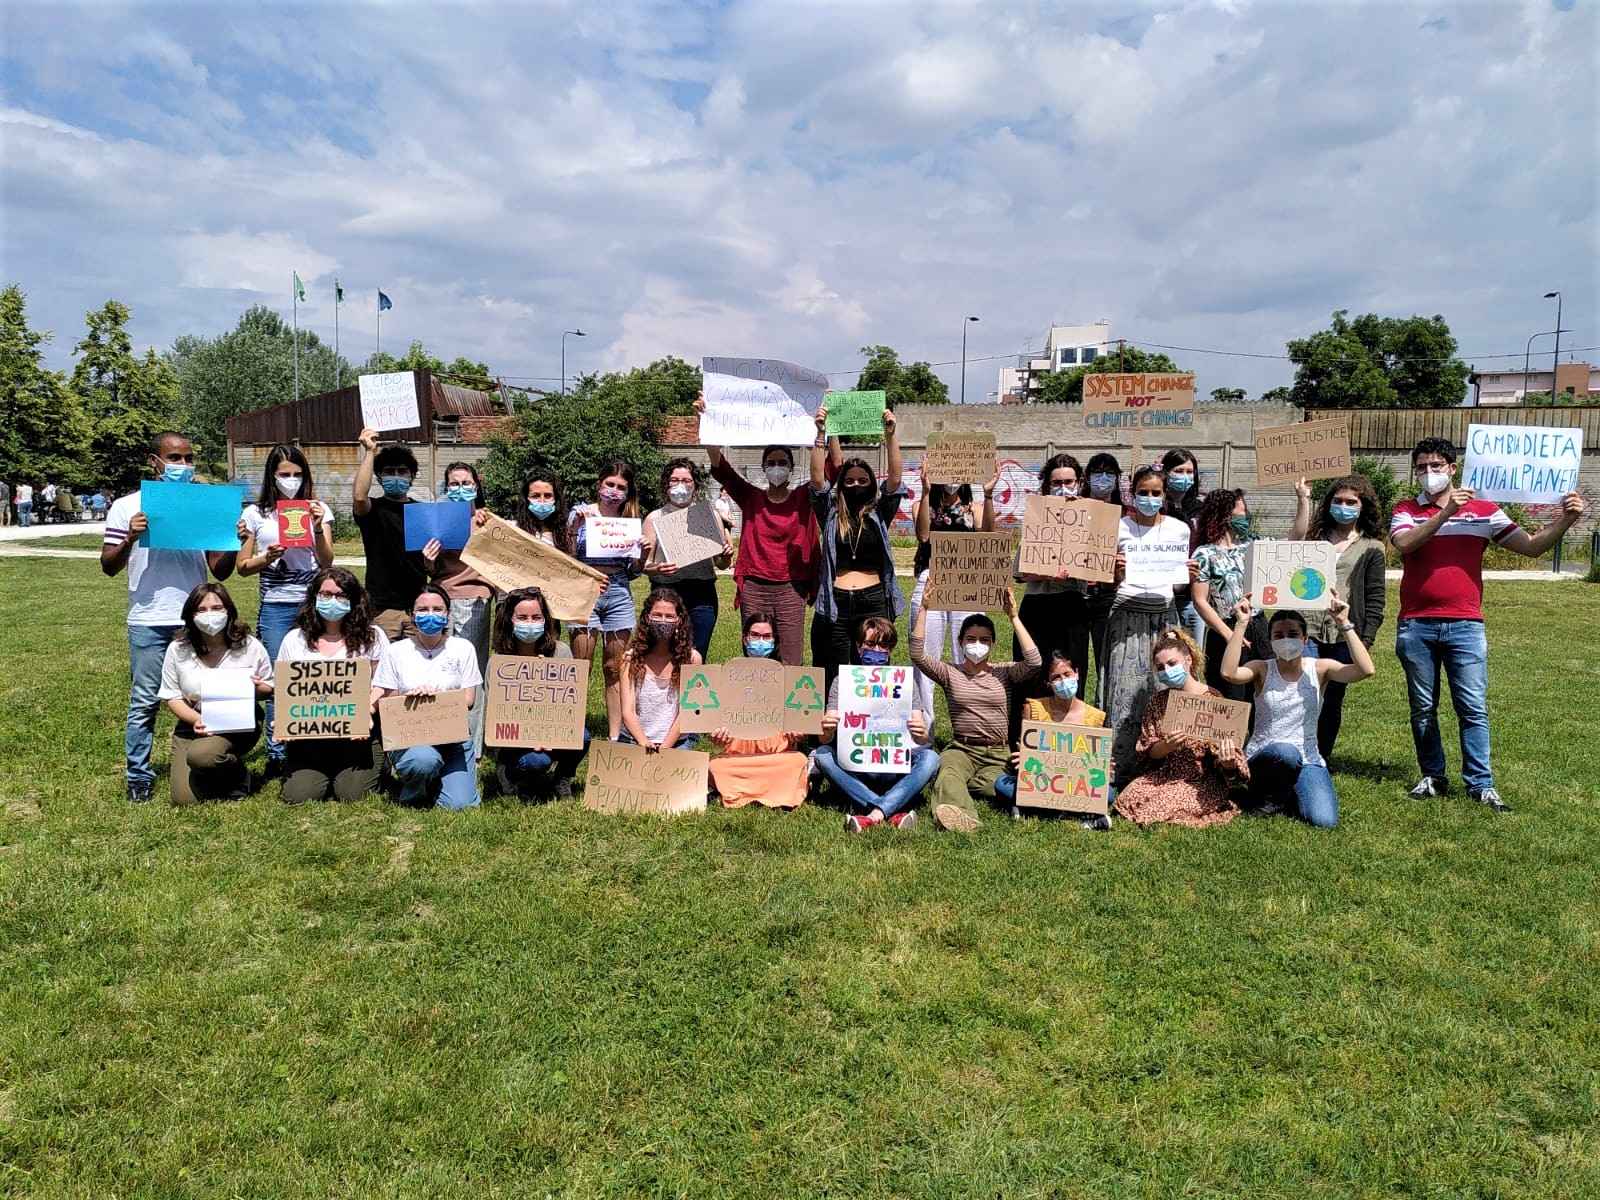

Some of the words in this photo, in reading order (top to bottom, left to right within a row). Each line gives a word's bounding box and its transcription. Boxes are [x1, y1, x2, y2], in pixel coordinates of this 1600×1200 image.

[1085, 374, 1145, 397] SYSTEM
[1147, 376, 1194, 392] CHANGE
[1125, 396, 1155, 407] NOT
[1085, 410, 1137, 428] CLIMATE
[1141, 409, 1193, 427] CHANGE
[1257, 433, 1299, 448] CLIMATE
[1302, 426, 1346, 443] JUSTICE
[1523, 433, 1577, 458] DIETA
[1264, 460, 1299, 475] SOCIAL
[1302, 456, 1345, 473] JUSTICE
[1510, 466, 1520, 490] IL
[1045, 506, 1088, 527] NOI
[935, 539, 959, 554] HOW
[960, 538, 976, 554] TO
[979, 538, 1010, 554] REPENT
[1024, 525, 1064, 542] NON
[1071, 529, 1116, 549] SIAMO
[1140, 544, 1151, 552] UN
[935, 556, 957, 570] FROM
[959, 556, 989, 570] CLIMATE
[1024, 545, 1115, 574] INNOCENTI
[934, 573, 952, 585] EAT
[957, 573, 978, 585] YOUR
[982, 573, 1009, 586] DAILY
[1256, 566, 1282, 585] NO
[936, 589, 960, 605] RICE
[962, 590, 978, 602] and
[980, 587, 1009, 606] BEAN
[1263, 586, 1278, 605] B
[290, 660, 357, 681] SYSTEM
[496, 662, 577, 682] CAMBIA
[851, 667, 906, 683] SSTM
[287, 680, 353, 698] CHANGE
[497, 681, 578, 704] TESTA
[310, 695, 330, 703] not
[289, 704, 357, 718] CLIMATE
[512, 704, 576, 722] PIANETA
[844, 710, 871, 730] NOT
[287, 720, 352, 737] CHANGE
[496, 723, 519, 740] NON
[851, 730, 904, 747] CLIMATE
[1023, 728, 1112, 756] CLIMATE
[594, 748, 633, 779] Non
[669, 766, 700, 784] un
[850, 748, 910, 765] CANE!
[1018, 771, 1102, 799] SOCIAL
[597, 785, 672, 813] PIANETA
